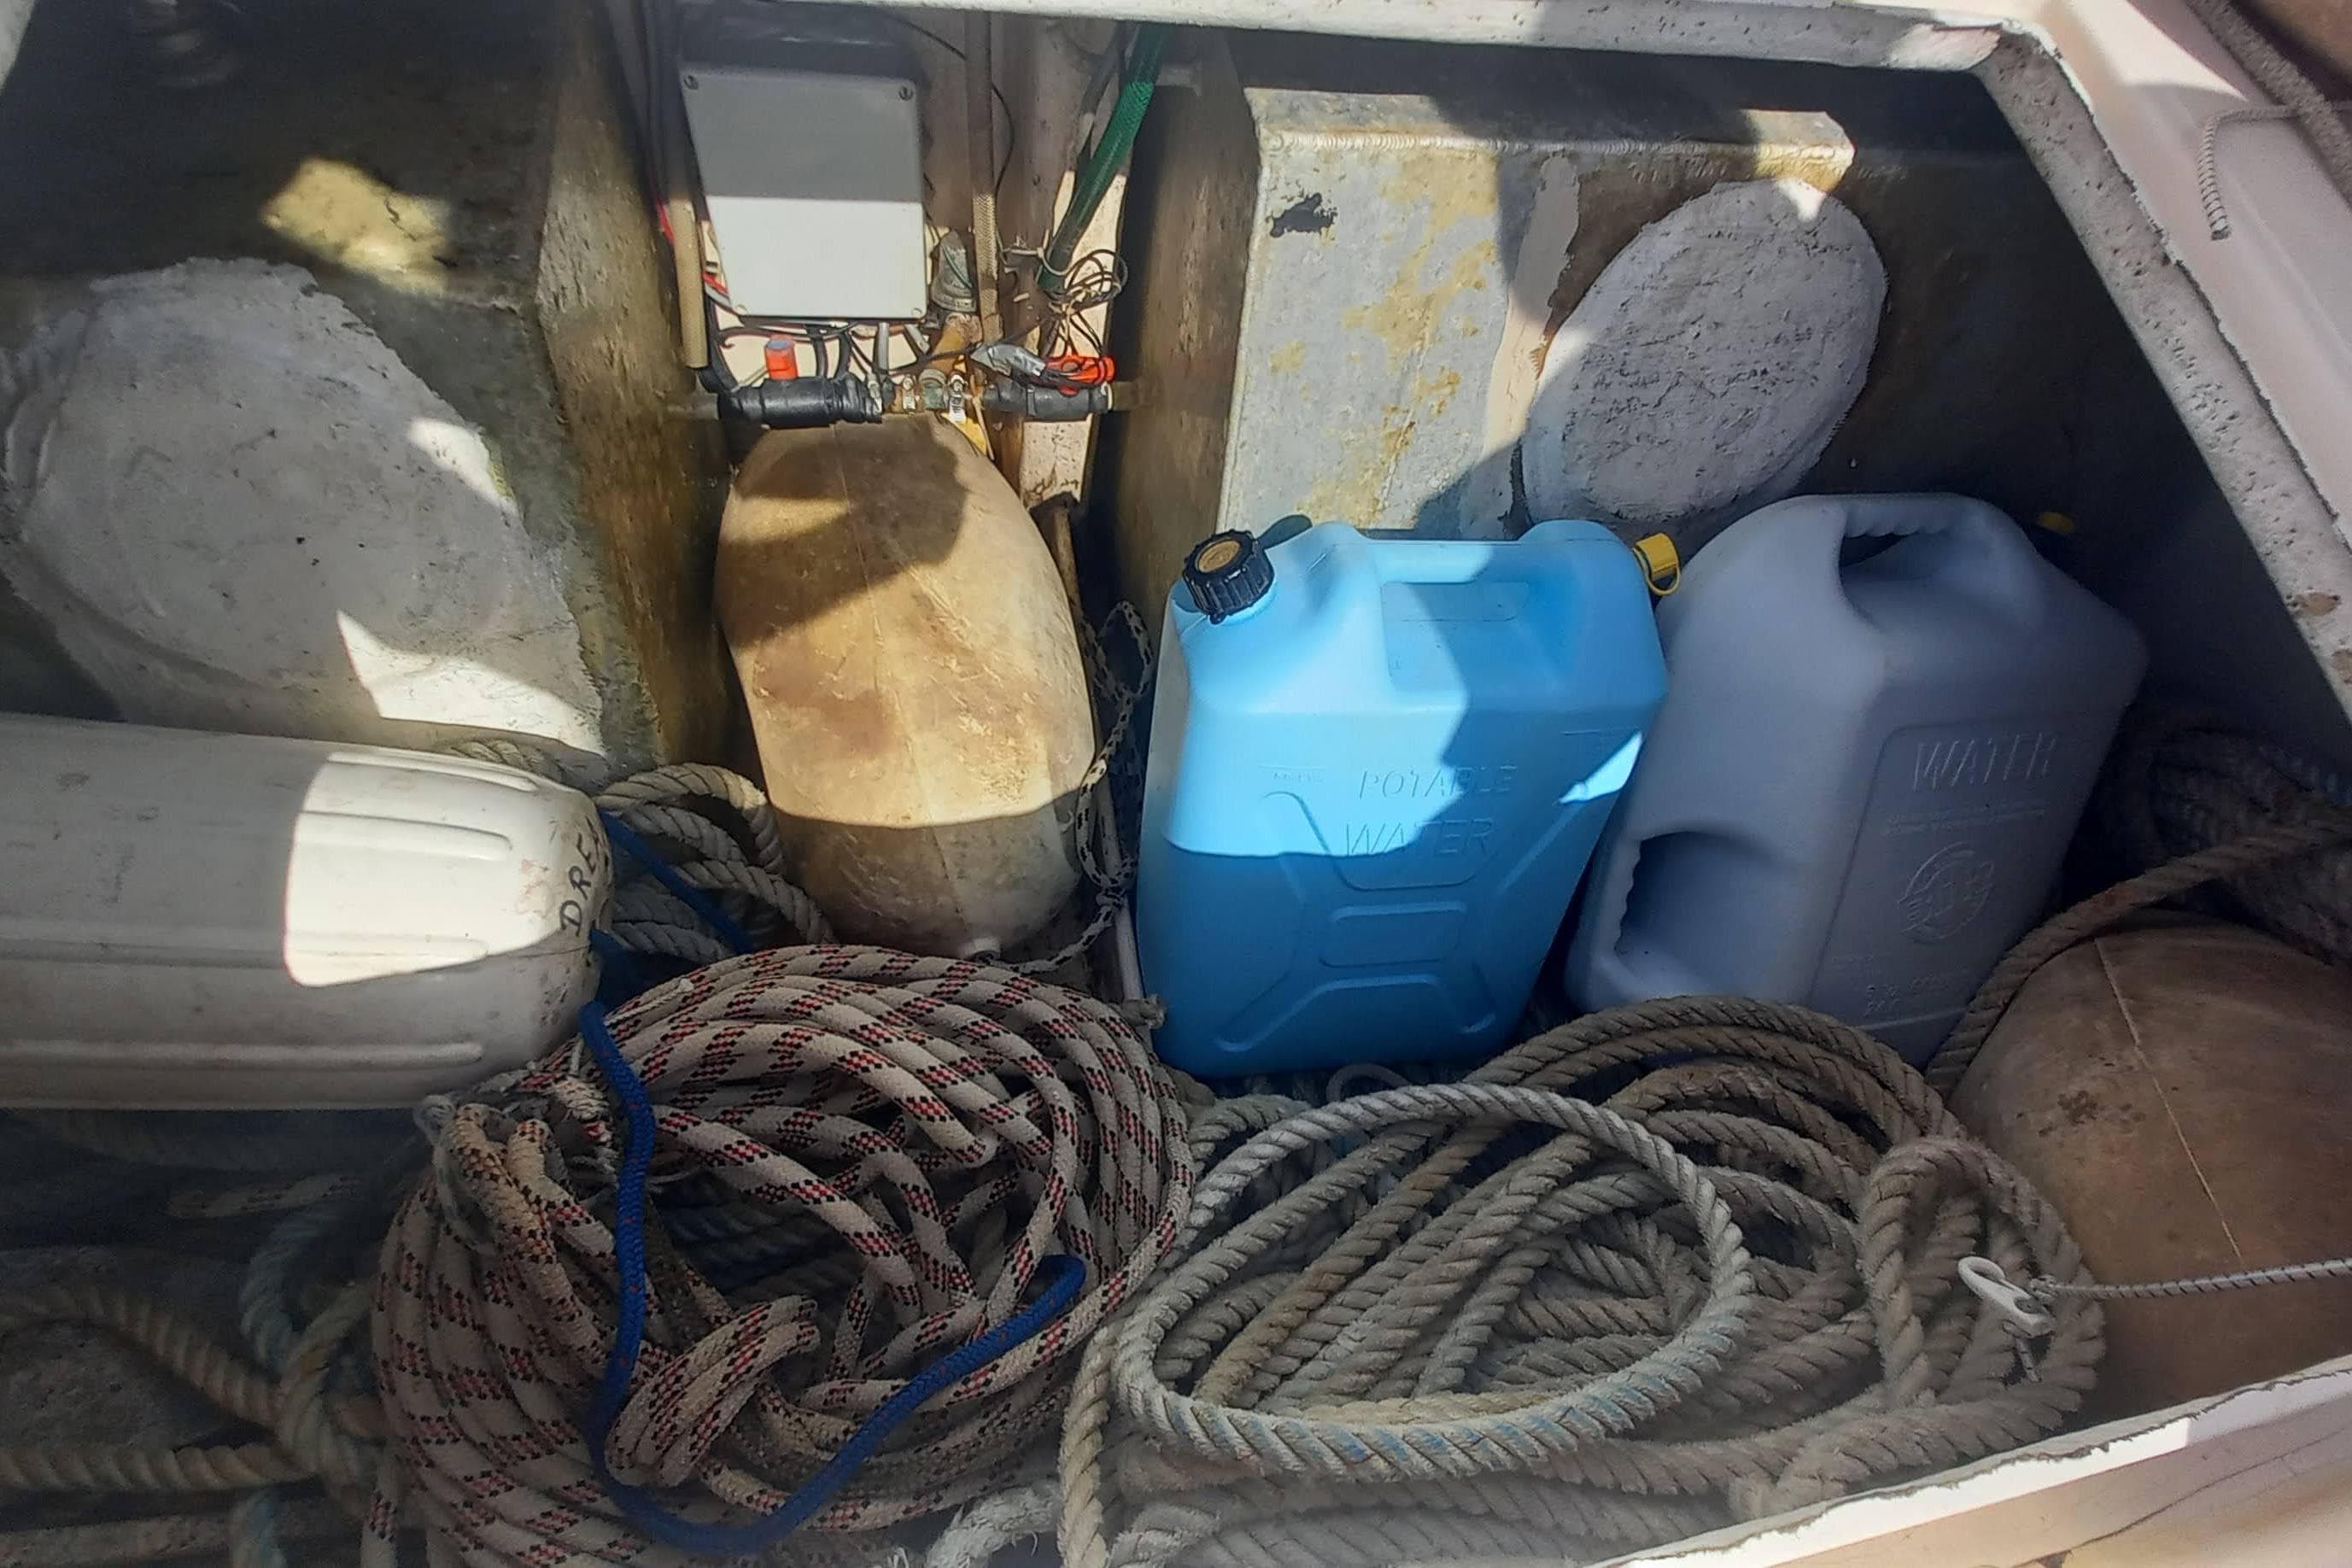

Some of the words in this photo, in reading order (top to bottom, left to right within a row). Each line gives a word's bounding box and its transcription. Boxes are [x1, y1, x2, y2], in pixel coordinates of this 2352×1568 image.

[1912, 732, 2057, 792] WATER
[1359, 766, 1518, 799] POTABLE
[1345, 819, 1494, 856] WATER
